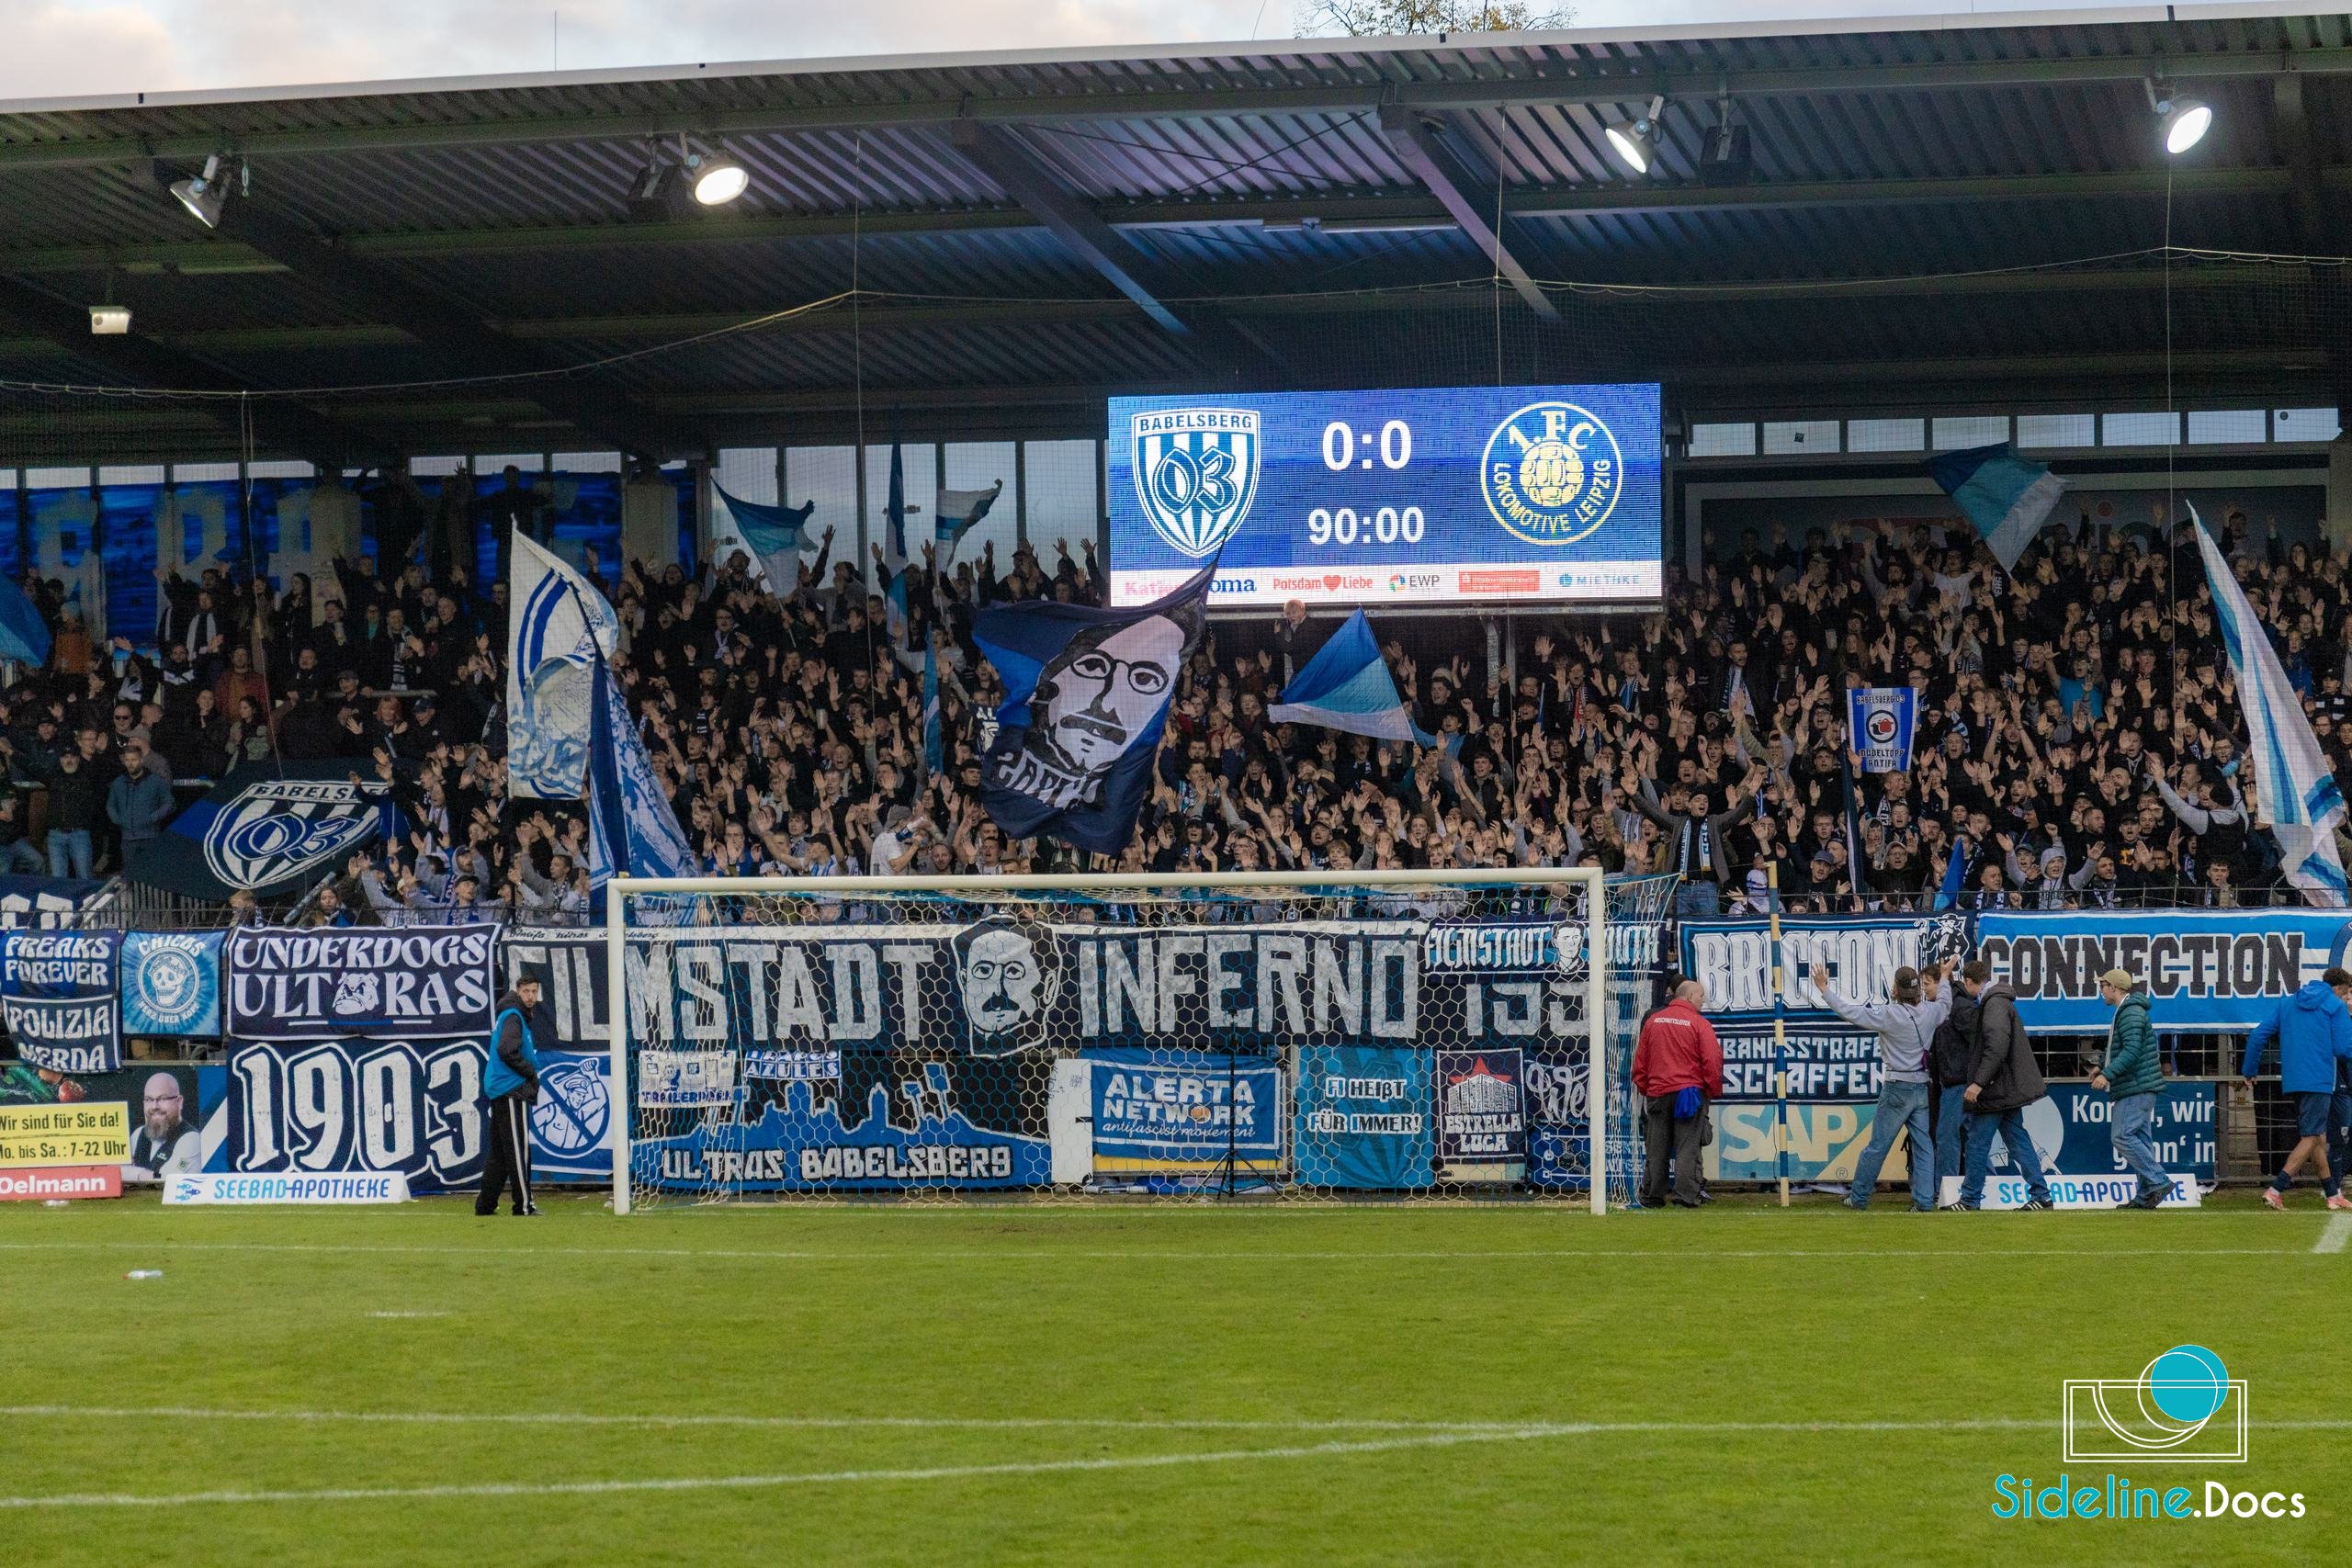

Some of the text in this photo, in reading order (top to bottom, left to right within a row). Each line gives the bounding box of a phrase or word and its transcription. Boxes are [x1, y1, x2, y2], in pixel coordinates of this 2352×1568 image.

[1140, 414, 1251, 432] BABELSBERG
[1322, 421, 1412, 470] 0:0
[1153, 446, 1238, 514] 03
[1493, 459, 1611, 533] LOKOMOTIVE LEIPZIG
[1308, 506, 1425, 546] 90:00
[1273, 576, 1374, 591] Potsdam Liebe
[1409, 574, 1440, 588] EWP
[232, 812, 361, 862] 03
[6, 936, 112, 959] FREAKS
[138, 934, 206, 957] CHICOS
[233, 933, 489, 969] UNDERDOGS
[6, 960, 108, 986] FOREVER
[1977, 932, 2304, 999] CONNECTION
[507, 943, 935, 1043] FILMSTADT
[1079, 932, 1420, 1039] INFERNO
[9, 1005, 111, 1039] POLIZIA
[18, 1043, 107, 1071] MERDA
[745, 1061, 838, 1077] AZULES
[1105, 1074, 1255, 1104] ALERTA
[0, 1111, 119, 1131] Wir sind für Sie da!
[235, 1047, 485, 1174] 1903
[2171, 1092, 2216, 1122] wir
[1102, 1121, 1181, 1139] antifascist
[1308, 1109, 1421, 1134] FÜR IMMER!
[1444, 1113, 1523, 1134] ESTRELLA
[1720, 1105, 1858, 1162] SAP
[18, 1145, 37, 1158] bis
[104, 1140, 127, 1156] Uhr
[1460, 1134, 1510, 1153] LUCA
[2194, 1133, 2216, 1163] in
[662, 1146, 1012, 1180] ULTRAS BABELSBERG
[0, 1175, 106, 1194] Oelmann
[214, 1179, 390, 1199] SEEBAD-APOTHEKE
